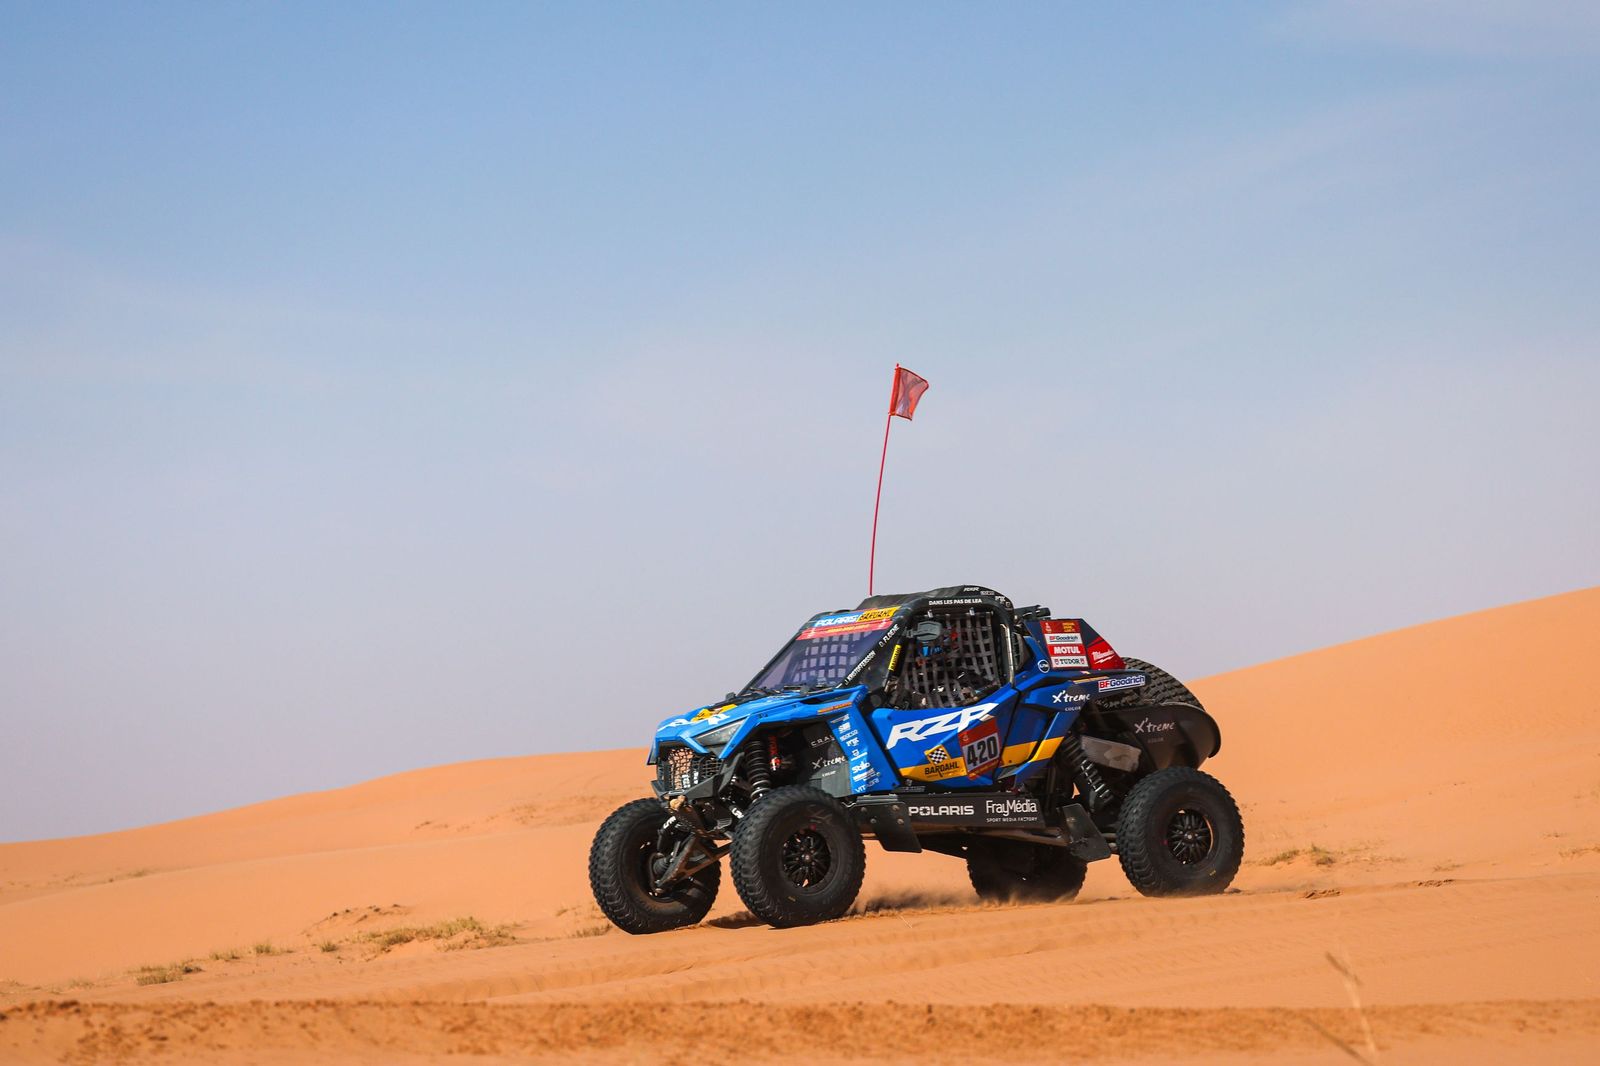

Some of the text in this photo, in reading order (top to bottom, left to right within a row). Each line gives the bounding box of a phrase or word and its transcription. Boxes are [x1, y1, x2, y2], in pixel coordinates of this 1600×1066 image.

[813, 614, 859, 627] POLARIS
[1053, 646, 1081, 654] MOTUL
[1099, 675, 1145, 688] BFGoodrich
[886, 702, 999, 750] RZR
[967, 736, 998, 767] 420
[925, 762, 959, 776] BARDAHL
[908, 805, 975, 816] POLARIS
[986, 799, 1038, 816] FrayMédia
